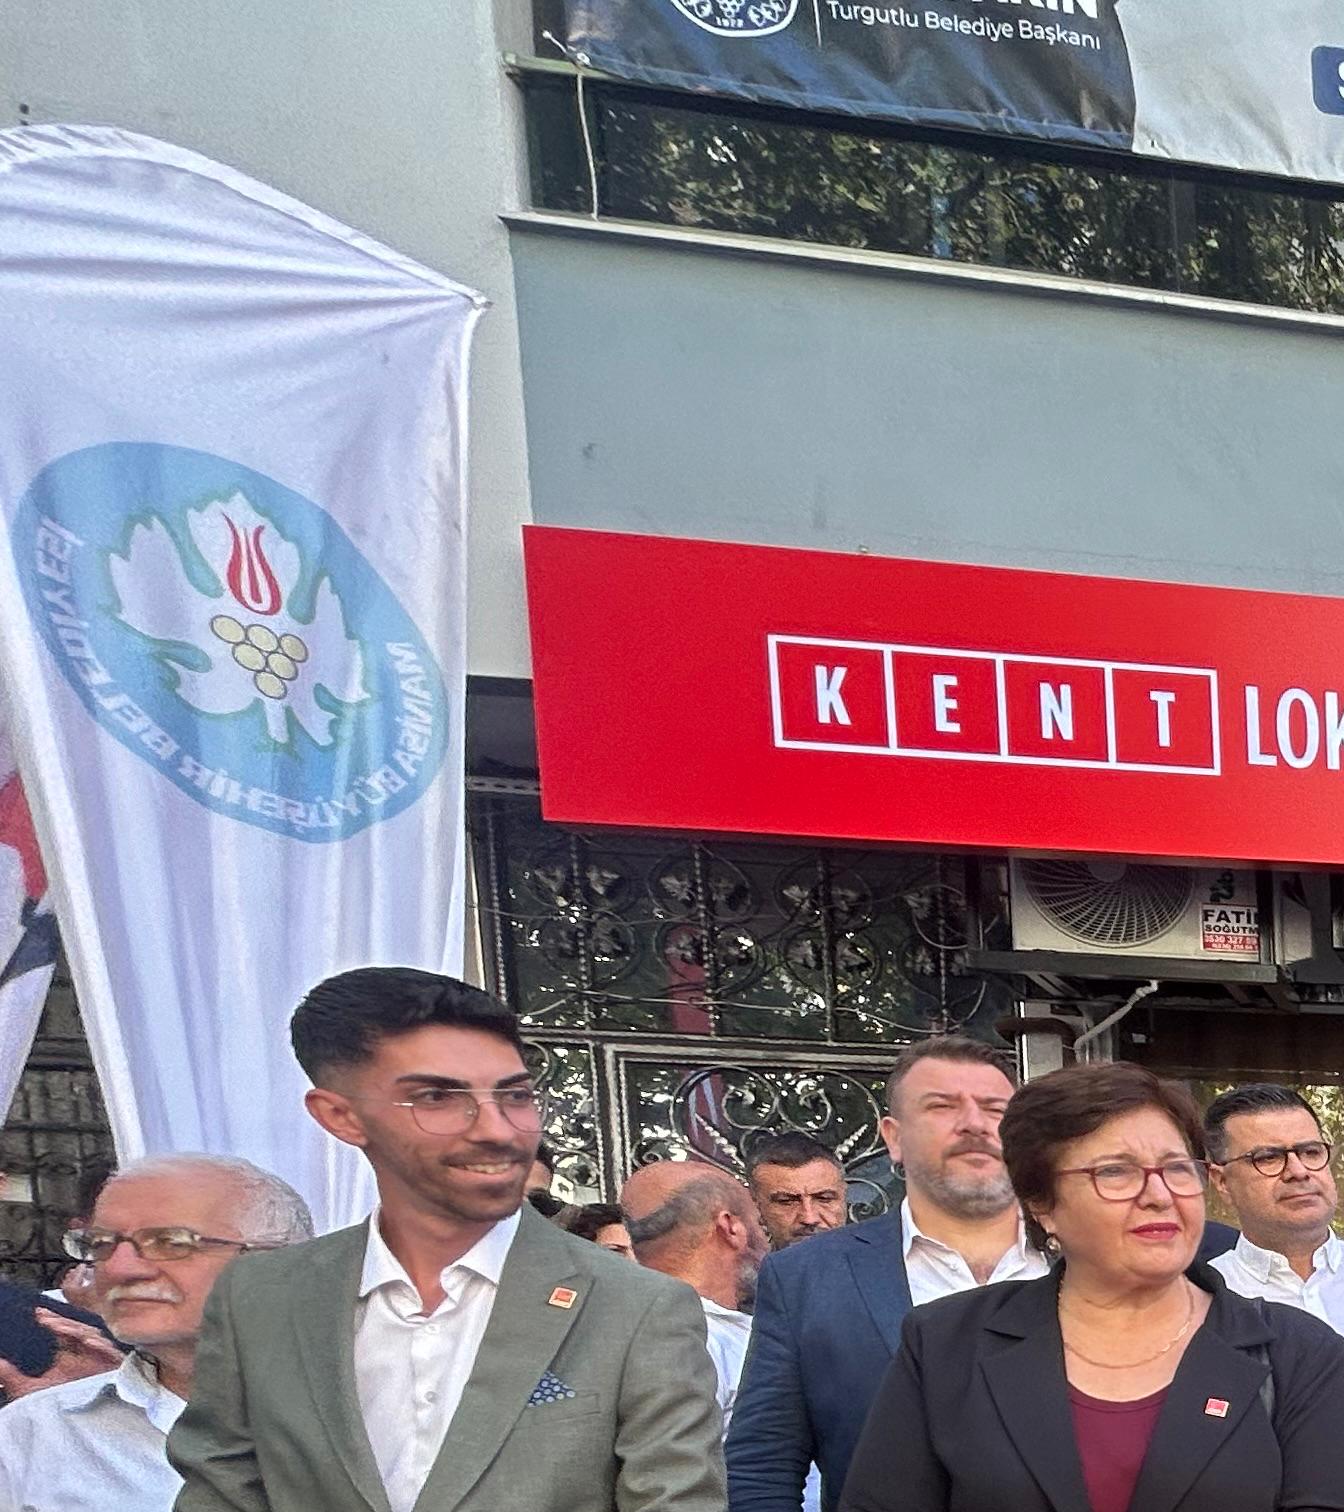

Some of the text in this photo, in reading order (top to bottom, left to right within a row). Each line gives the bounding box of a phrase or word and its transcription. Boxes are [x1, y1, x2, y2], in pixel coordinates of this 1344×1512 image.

[827, 0, 1101, 50] Turgutlu Belediye Başkanı
[815, 664, 1176, 747] KENT
